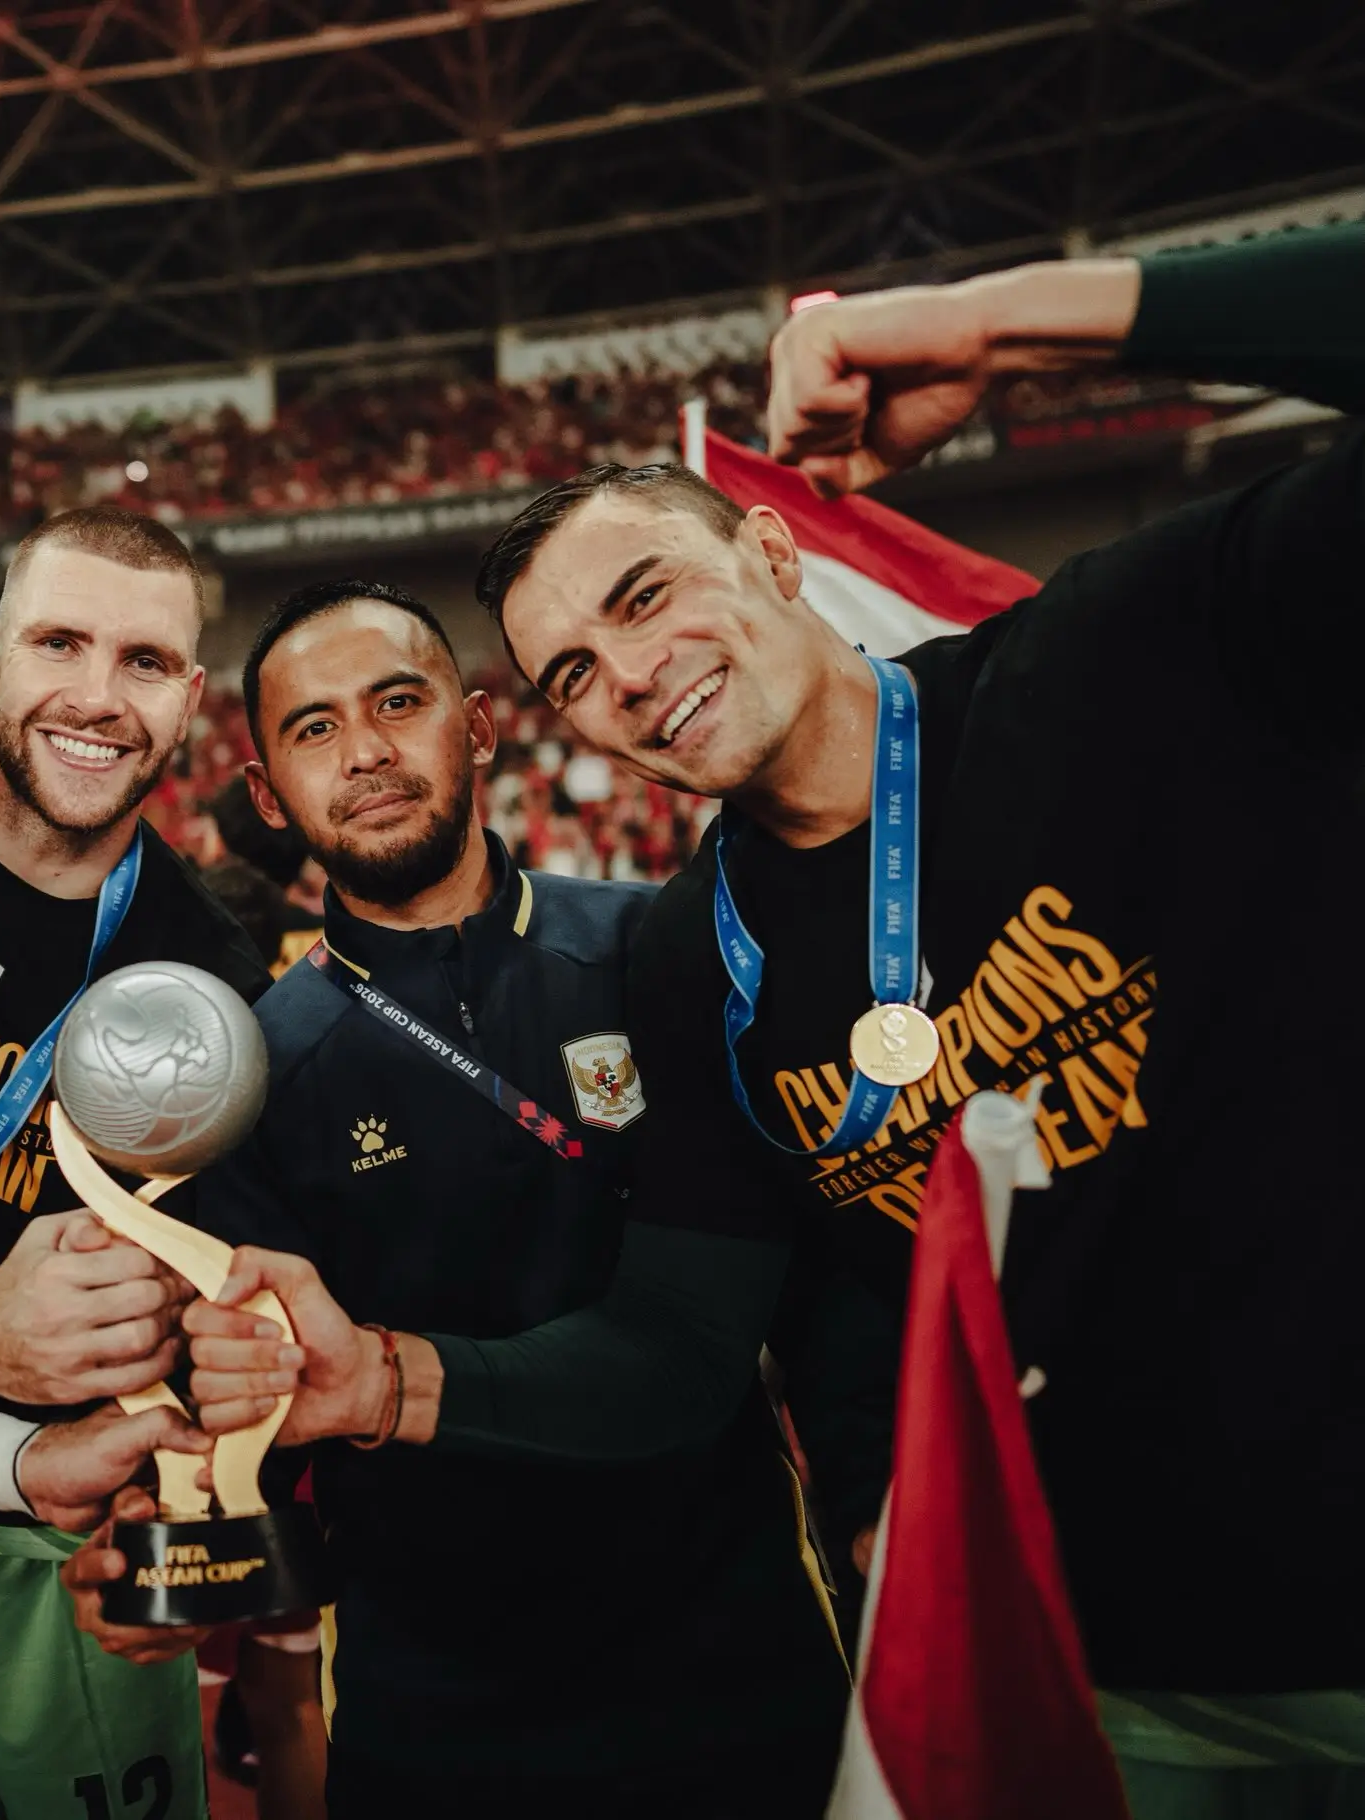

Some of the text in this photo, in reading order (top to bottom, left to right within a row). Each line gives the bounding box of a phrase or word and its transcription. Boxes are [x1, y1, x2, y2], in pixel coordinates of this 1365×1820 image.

[890, 737, 903, 770] FIFA
[888, 790, 902, 825] FIFA
[888, 845, 901, 880] FIFA
[887, 899, 901, 935] FIFA
[886, 953, 900, 988] FIFA
[383, 1005, 409, 1028] CUP
[36, 1040, 54, 1067] FIFA
[407, 1021, 452, 1058] ASEAN
[451, 1051, 481, 1079] FIFA
[13, 1077, 33, 1104] FIFA
[859, 1089, 879, 1122] FIFA
[819, 1152, 907, 1200] FOREVER
[1016, 1046, 1047, 1075] IN
[351, 1145, 408, 1173] KELME
[166, 1544, 210, 1565] FIFA
[135, 1565, 204, 1590] ASEAN
